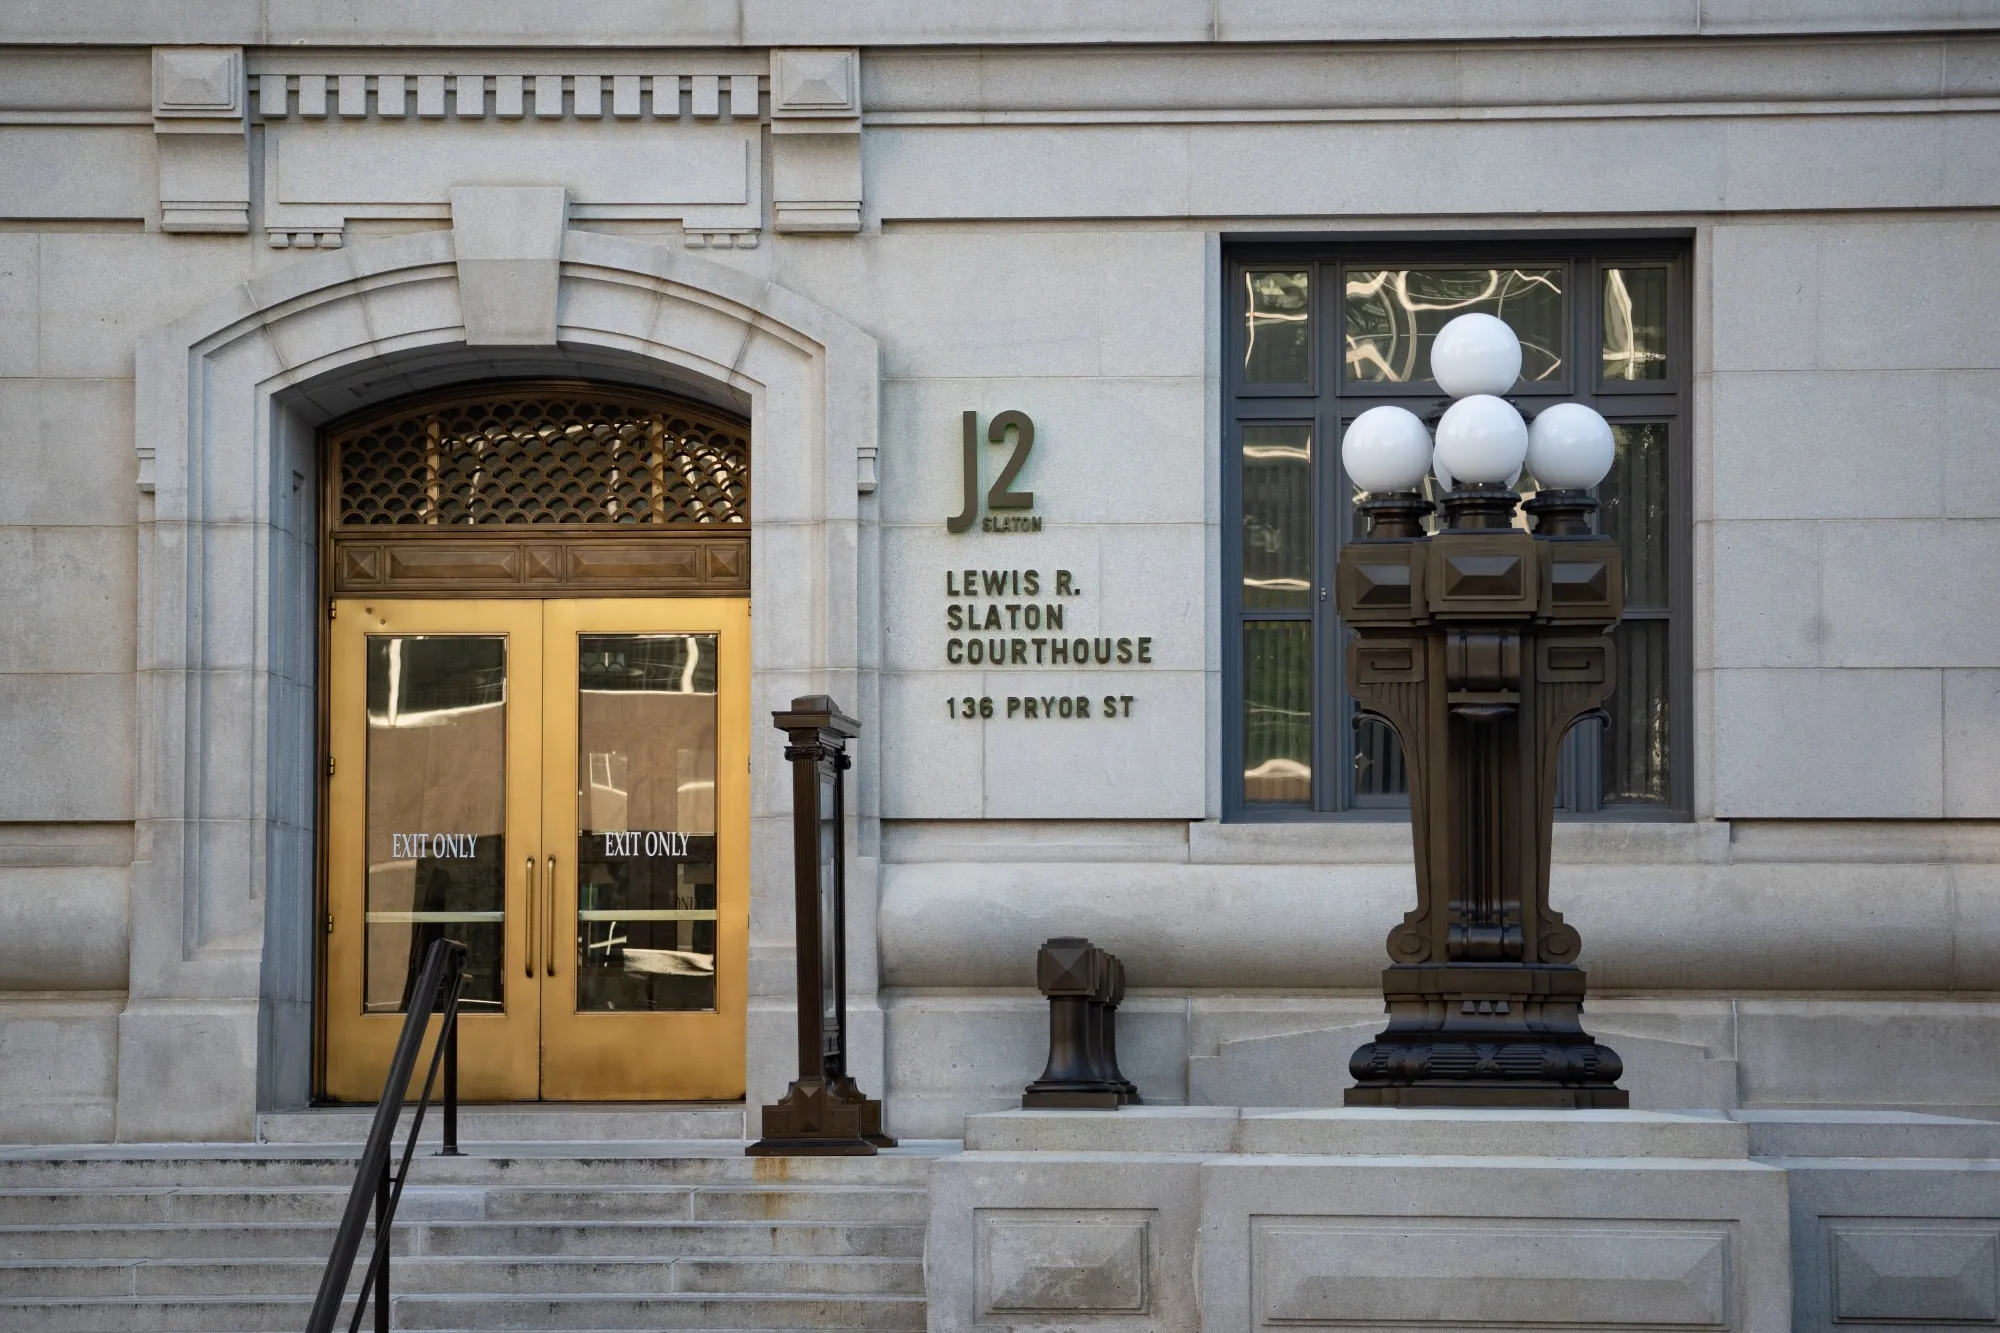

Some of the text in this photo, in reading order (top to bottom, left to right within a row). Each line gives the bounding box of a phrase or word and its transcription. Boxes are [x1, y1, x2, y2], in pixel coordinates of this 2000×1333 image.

[947, 410, 1035, 533] J2
[982, 516, 1042, 532] SLATON
[946, 570, 1081, 596] LEWIS R.
[947, 604, 1064, 630] SLATON
[946, 637, 1152, 665] COURTHOUSE
[946, 695, 1133, 719] 136 PRYOR ST
[392, 833, 478, 858] EXIT ONLY
[605, 831, 690, 856] EXIT ONLY
